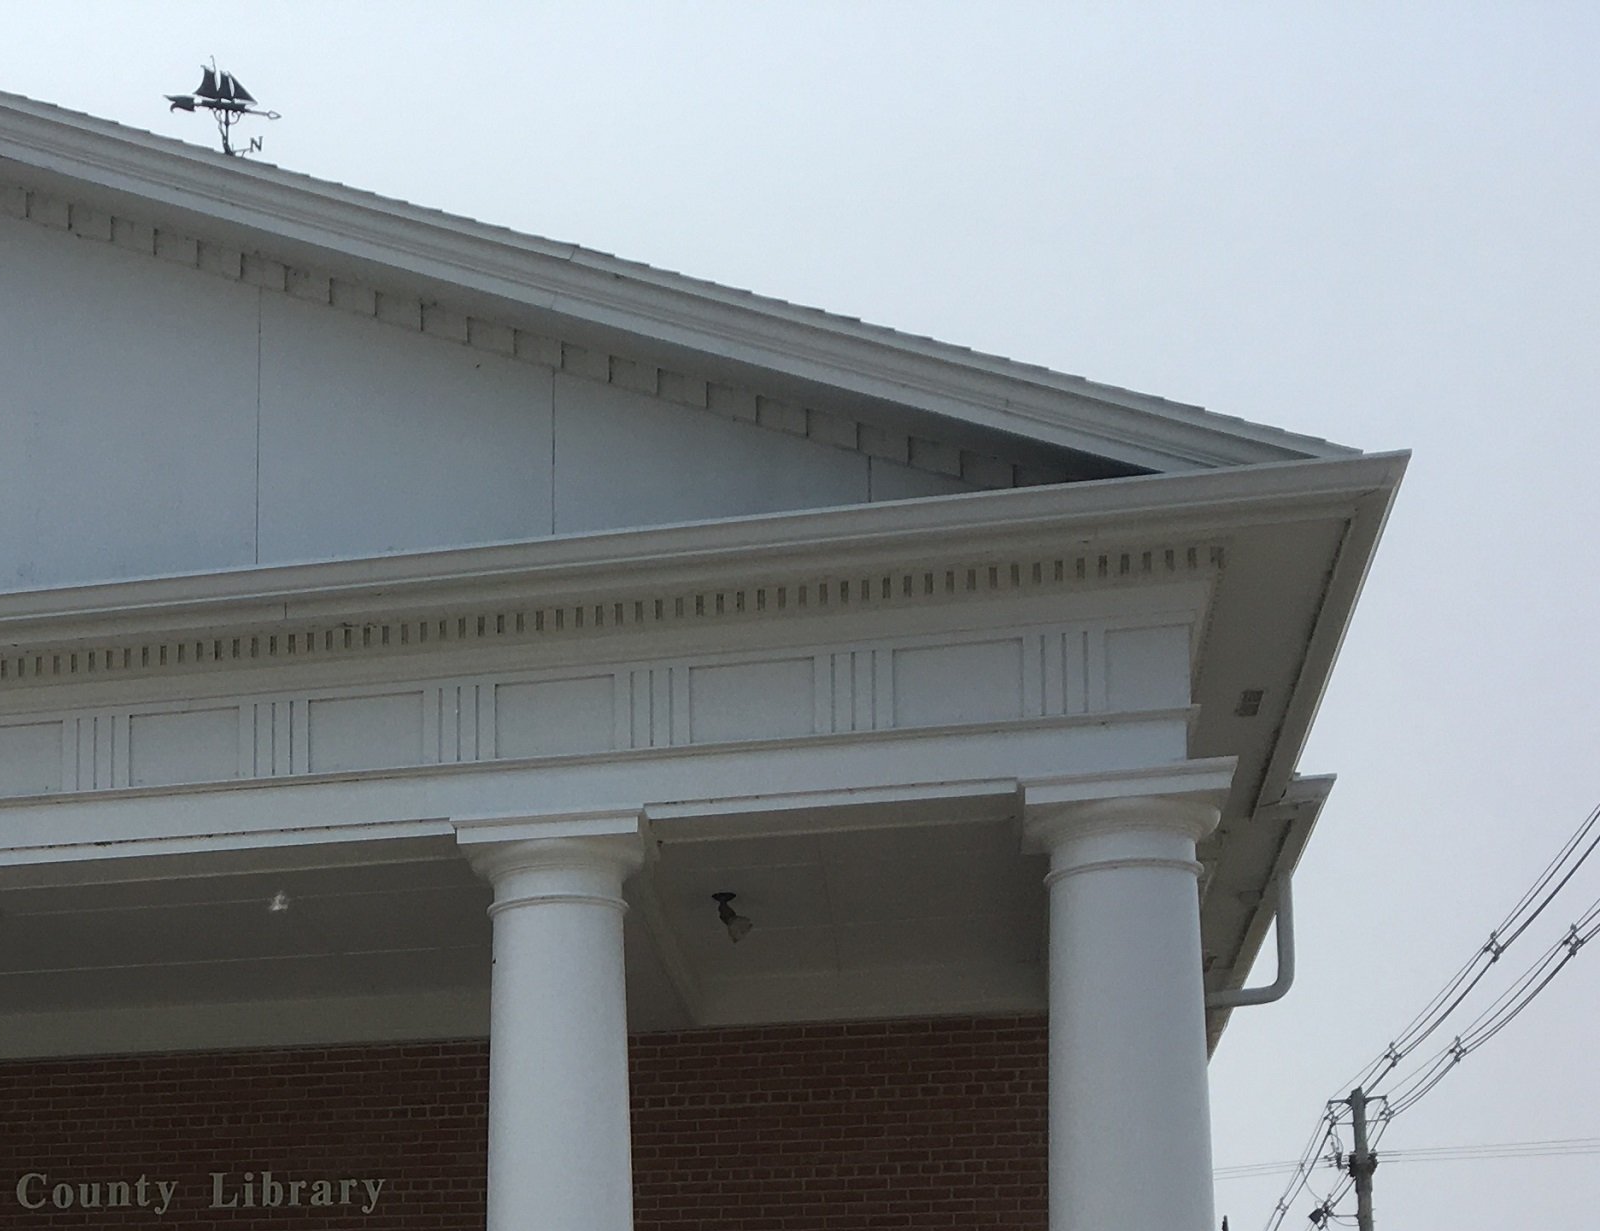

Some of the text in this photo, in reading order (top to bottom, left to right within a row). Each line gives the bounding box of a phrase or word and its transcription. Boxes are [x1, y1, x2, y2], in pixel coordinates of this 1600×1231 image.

[250, 136, 264, 153] N
[16, 1172, 179, 1215] County
[209, 1171, 387, 1215] Library
